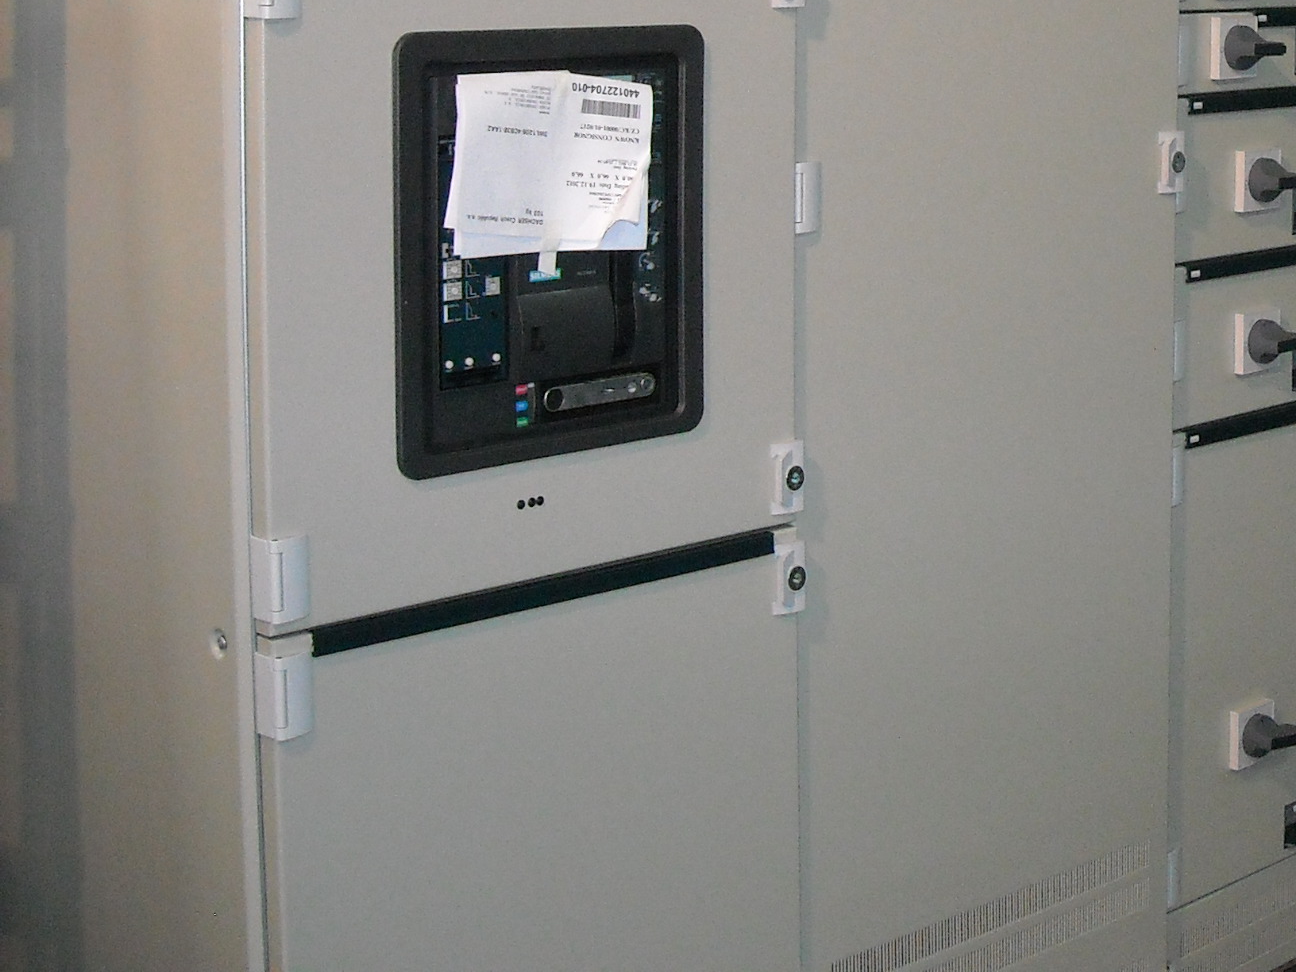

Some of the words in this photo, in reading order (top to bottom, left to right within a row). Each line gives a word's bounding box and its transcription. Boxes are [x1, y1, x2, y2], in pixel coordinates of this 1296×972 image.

[571, 82, 641, 99] 440122704-010
[573, 131, 613, 141] CONSIGNOR
[614, 135, 640, 144] KNOWN
